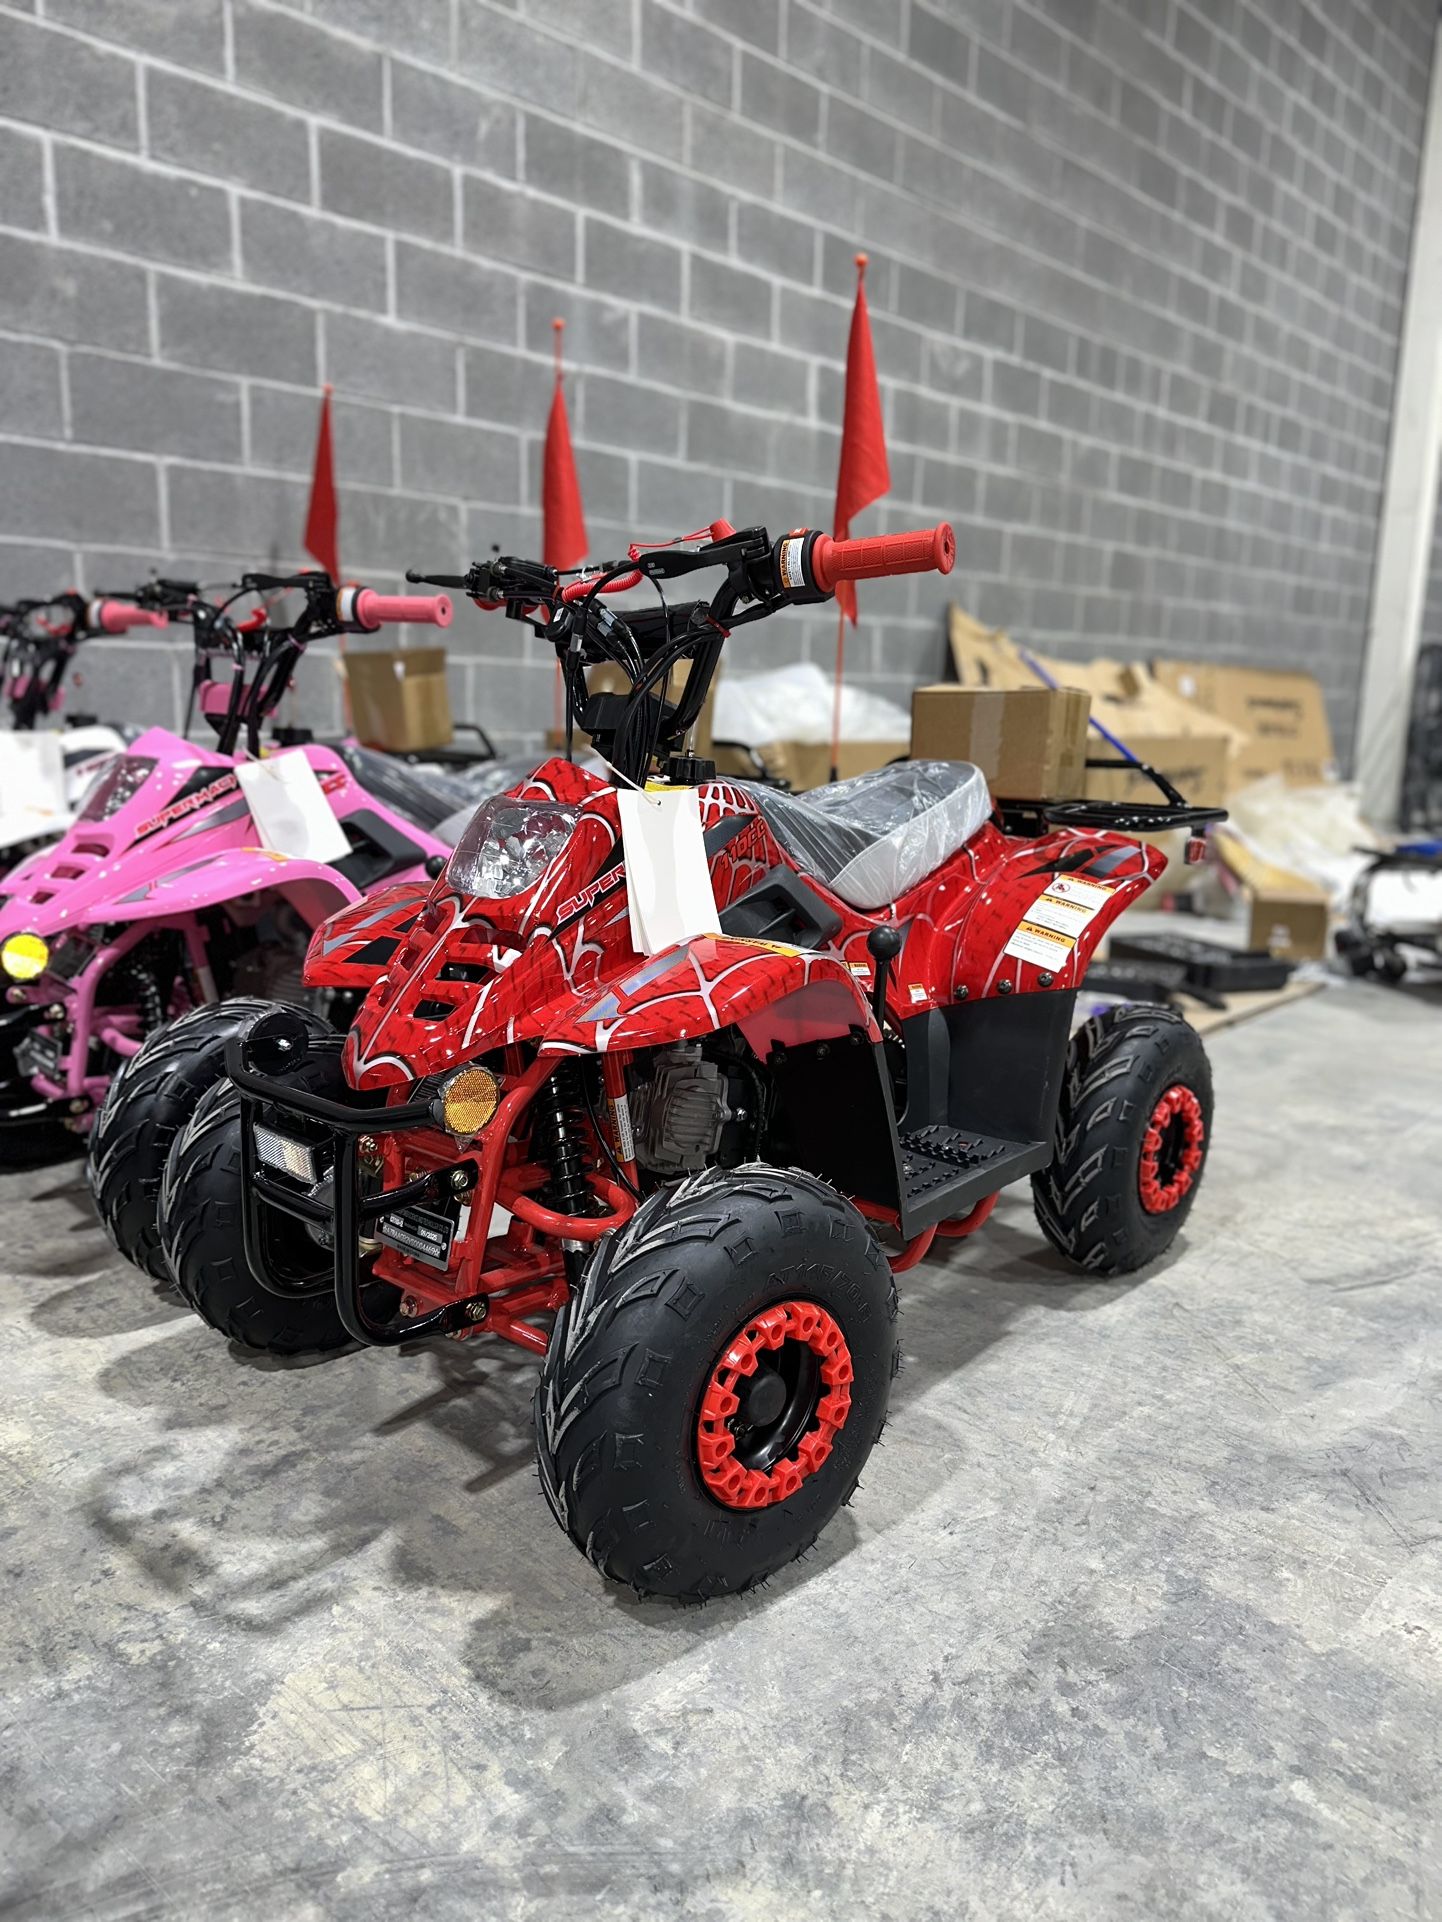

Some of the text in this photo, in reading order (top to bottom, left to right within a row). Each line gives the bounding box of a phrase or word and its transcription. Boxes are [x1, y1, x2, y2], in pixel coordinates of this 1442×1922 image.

[1077, 879, 1107, 891] WARNING
[1056, 899, 1087, 914] WARNING
[1034, 929, 1066, 943] WARNING
[610, 1104, 620, 1143] WARNING
